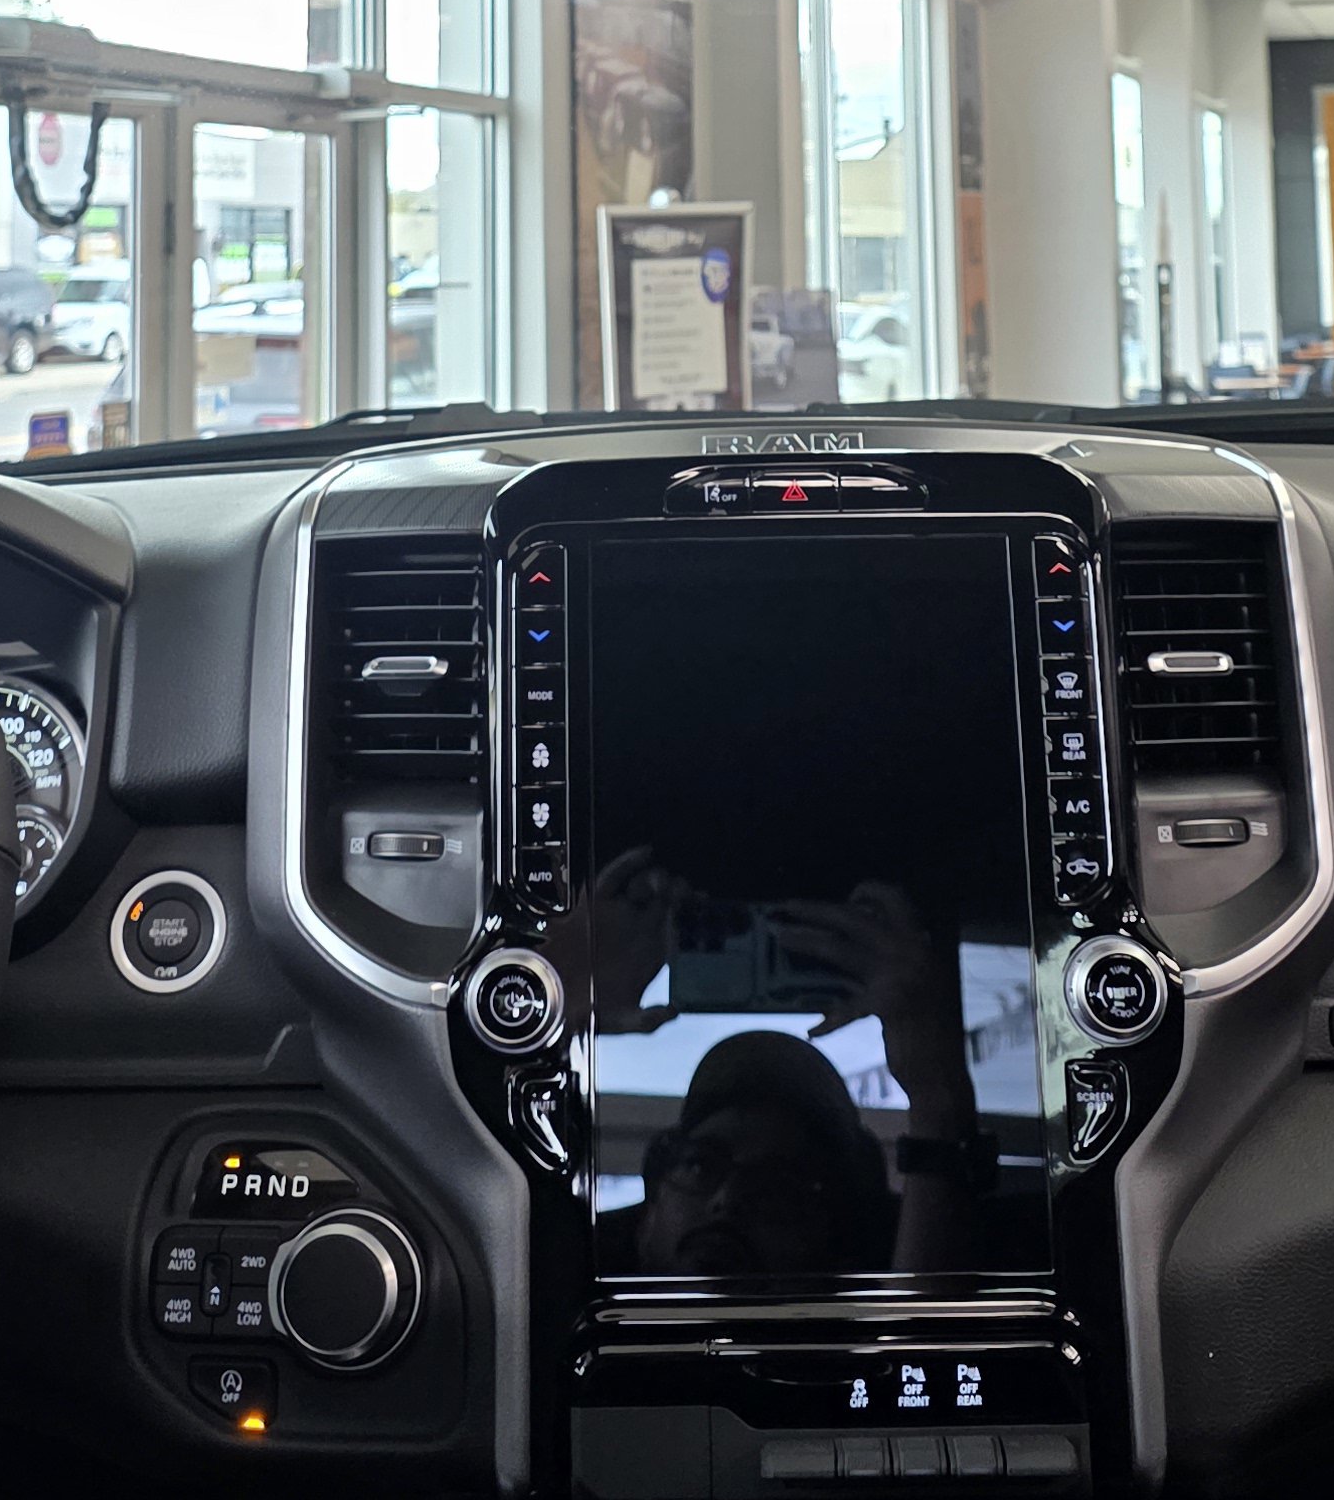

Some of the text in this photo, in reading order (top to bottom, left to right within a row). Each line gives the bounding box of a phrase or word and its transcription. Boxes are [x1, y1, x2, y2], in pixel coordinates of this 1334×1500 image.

[701, 432, 863, 455] RAM
[721, 494, 738, 502] OFF
[527, 691, 554, 701] MODE
[1055, 689, 1083, 700] FRONT
[0, 717, 25, 735] 100
[27, 748, 54, 767] 120
[35, 774, 62, 790] MPH
[1065, 800, 1091, 814] A/C
[528, 871, 553, 882] AUTO
[153, 918, 186, 927] START
[1076, 1091, 1115, 1103] SCREEN
[170, 1247, 196, 1259] 4WD
[168, 1259, 197, 1272] AUTO
[241, 1256, 267, 1268] 2WD
[166, 1299, 192, 1311] 4WD
[210, 1295, 220, 1306] N
[237, 1301, 262, 1314] 4WD
[164, 1311, 192, 1324] HIGH
[237, 1314, 262, 1326] LOW
[903, 1383, 924, 1395] OFF
[959, 1383, 979, 1394] OFF
[221, 1392, 240, 1403] OFF
[849, 1396, 869, 1409] OFF
[897, 1395, 931, 1407] FRONT
[956, 1394, 983, 1406] REAR
